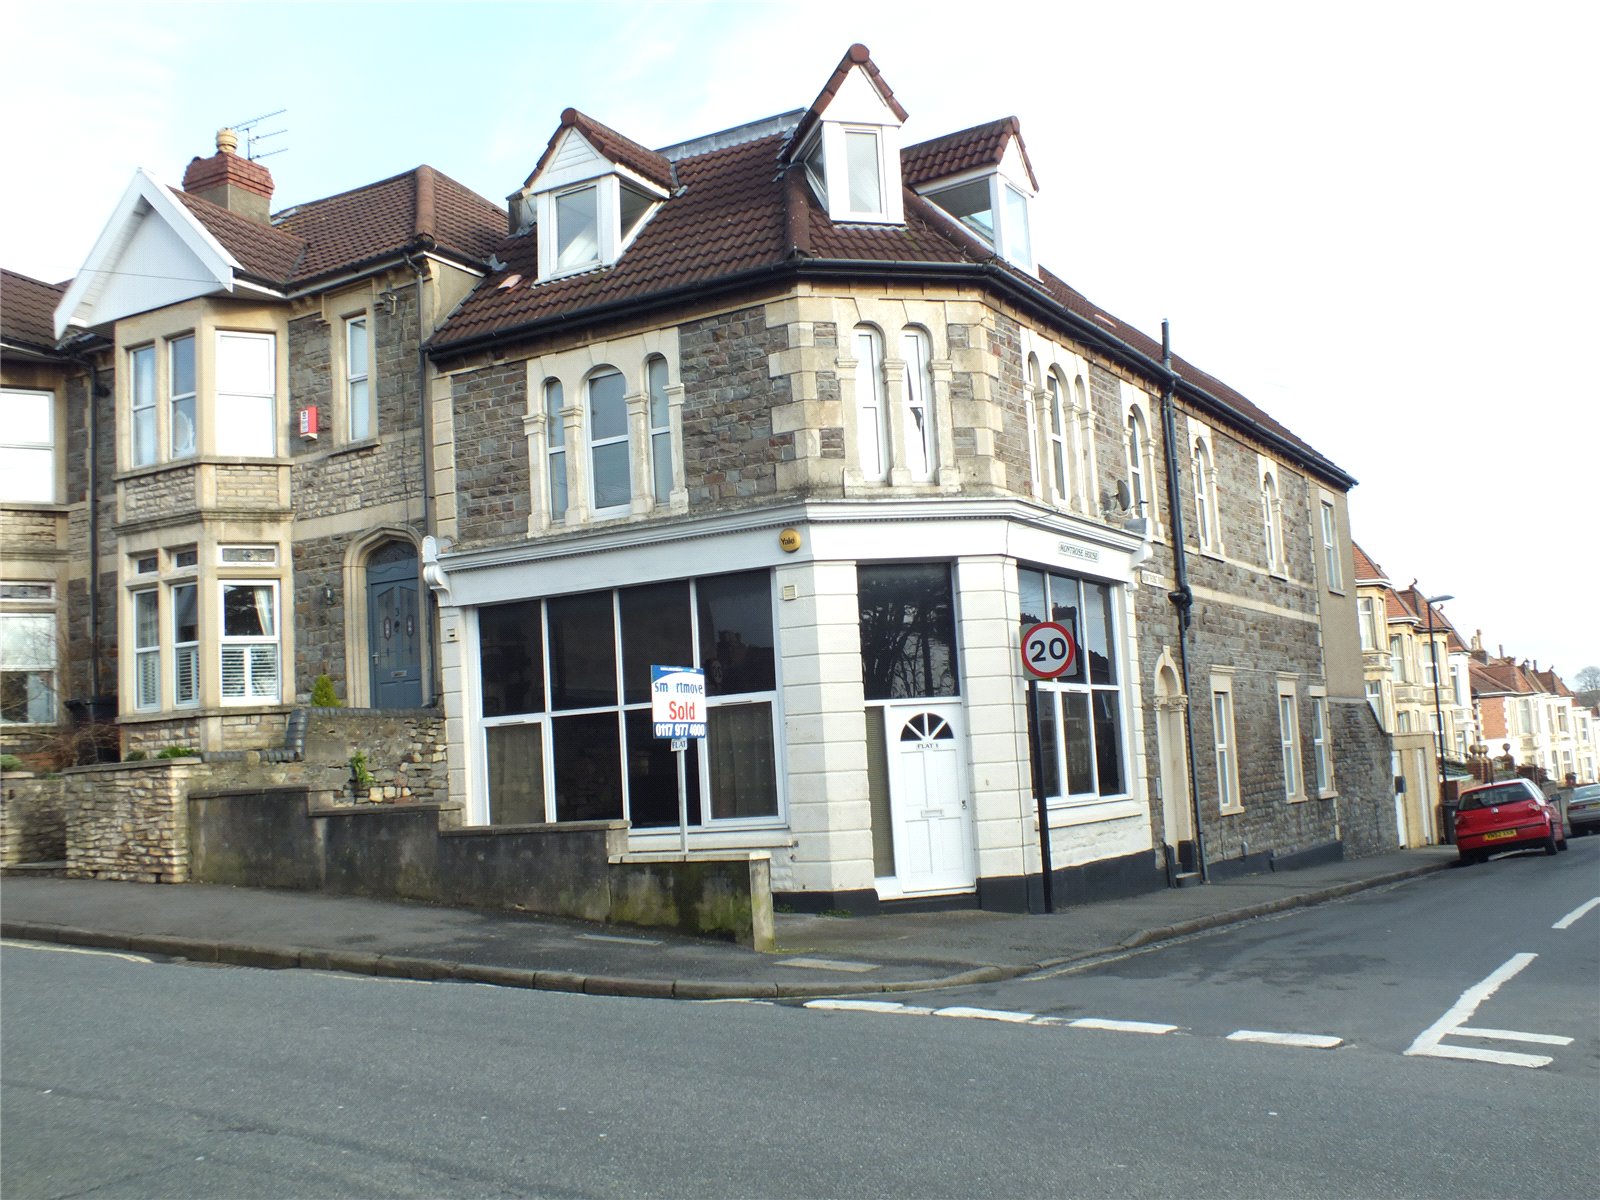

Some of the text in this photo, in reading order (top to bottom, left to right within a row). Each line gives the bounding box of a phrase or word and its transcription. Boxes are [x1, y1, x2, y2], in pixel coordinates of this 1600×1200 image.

[781, 537, 795, 545] Yale
[1030, 637, 1067, 662] 20
[655, 682, 703, 694] smrtmove
[669, 701, 695, 720] Sold
[655, 723, 673, 737] 0117
[675, 723, 689, 737] 977
[672, 741, 686, 749] FLAT
